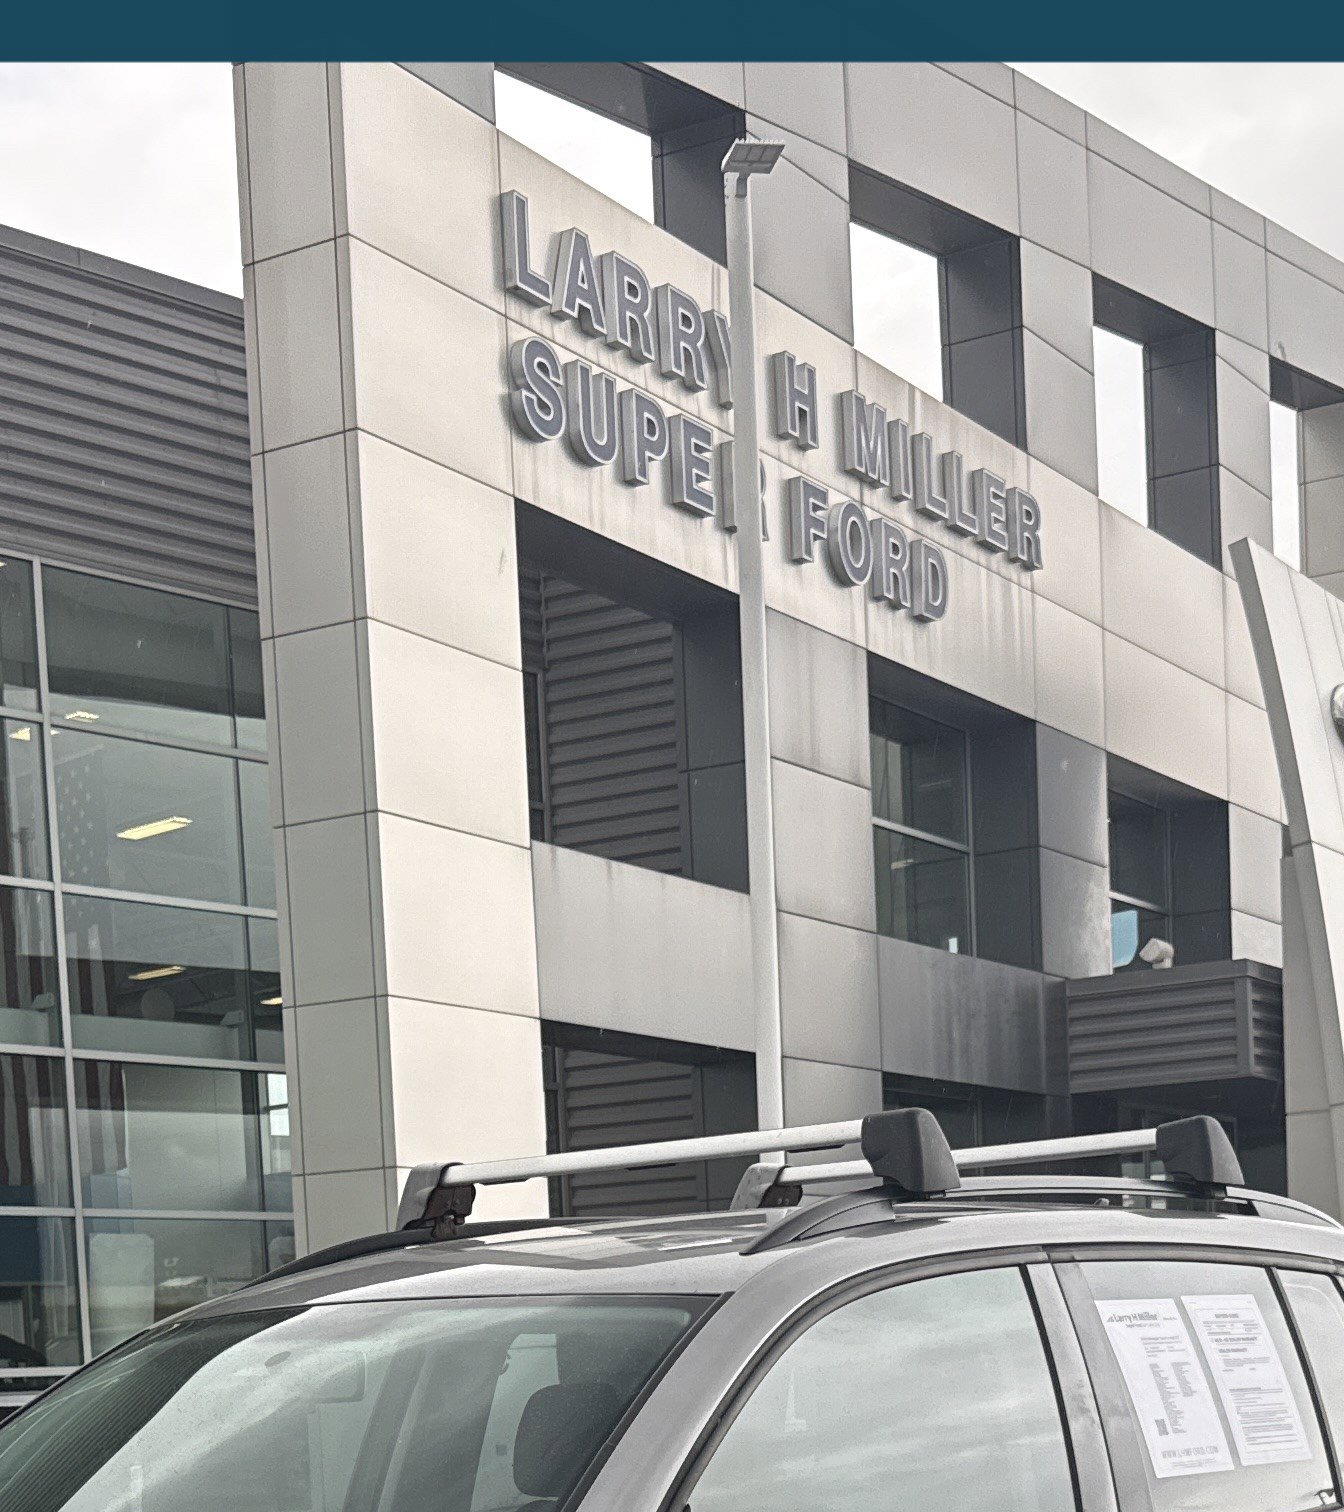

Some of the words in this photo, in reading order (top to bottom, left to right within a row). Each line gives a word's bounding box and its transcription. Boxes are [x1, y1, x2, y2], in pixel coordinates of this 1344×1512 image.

[773, 350, 819, 449] H
[840, 389, 1043, 571] MILLER
[788, 476, 949, 623] FORD
